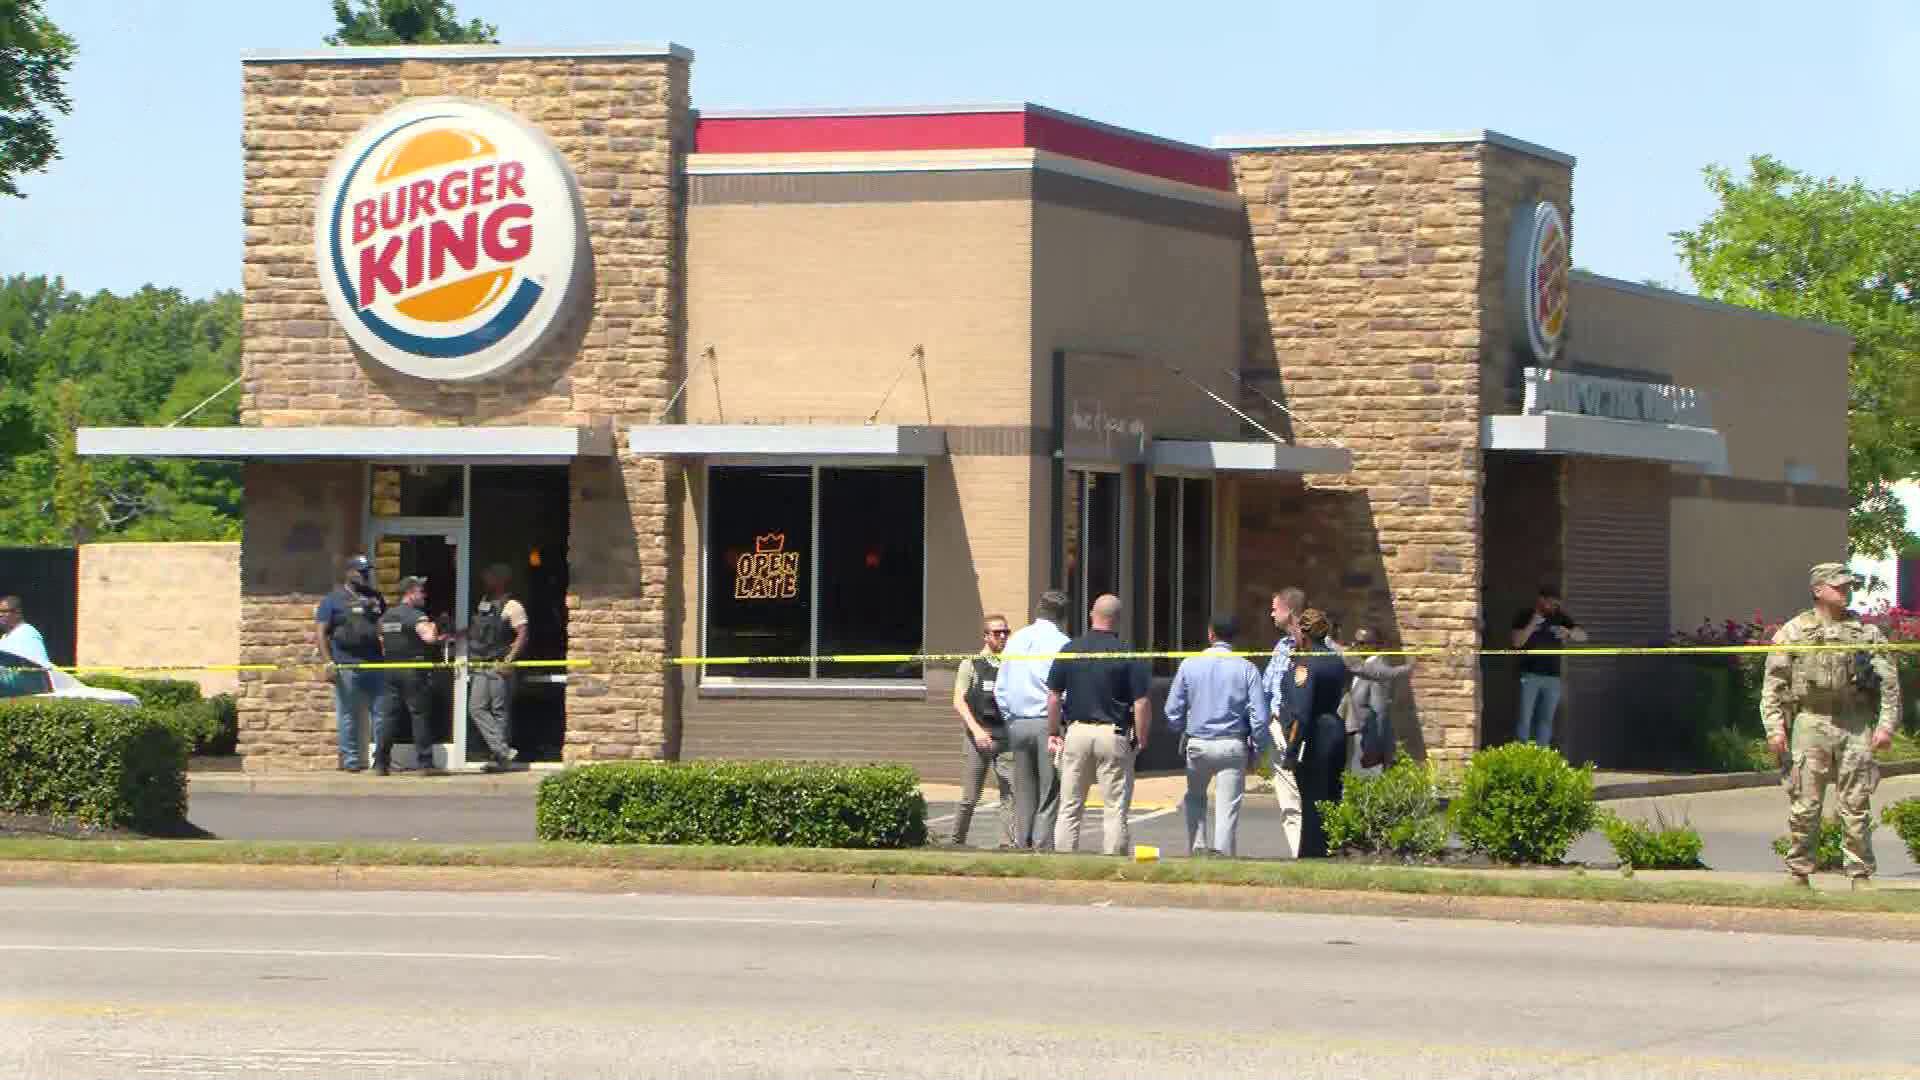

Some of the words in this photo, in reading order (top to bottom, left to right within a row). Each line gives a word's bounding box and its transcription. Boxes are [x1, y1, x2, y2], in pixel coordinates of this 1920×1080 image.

[352, 160, 526, 246] BURGER
[359, 203, 534, 309] KING
[735, 575, 798, 599] LATE
[736, 552, 800, 578] OPEN
